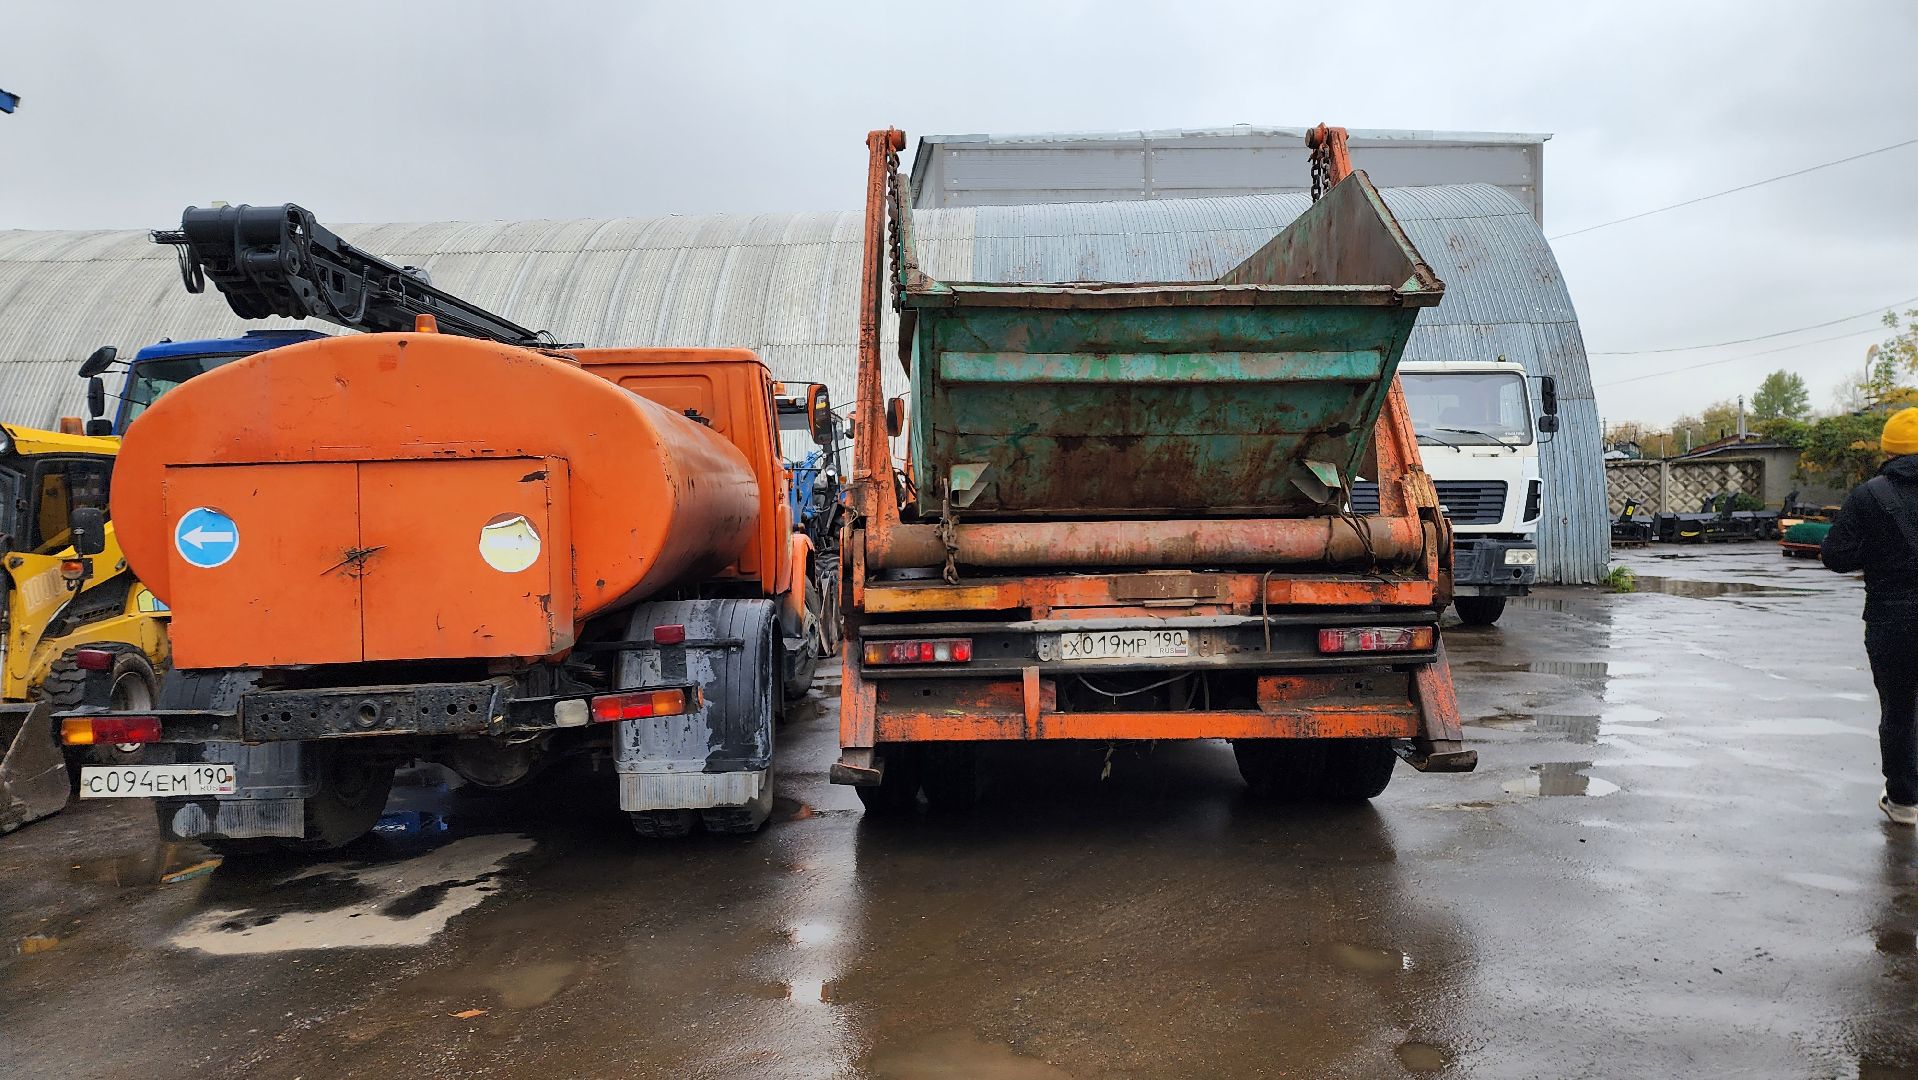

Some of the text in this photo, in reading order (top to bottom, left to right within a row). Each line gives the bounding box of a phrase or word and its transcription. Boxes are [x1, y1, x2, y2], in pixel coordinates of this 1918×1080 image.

[1069, 632, 1184, 656] Х019МР 190
[90, 767, 227, 793] С094ЕМ 190
